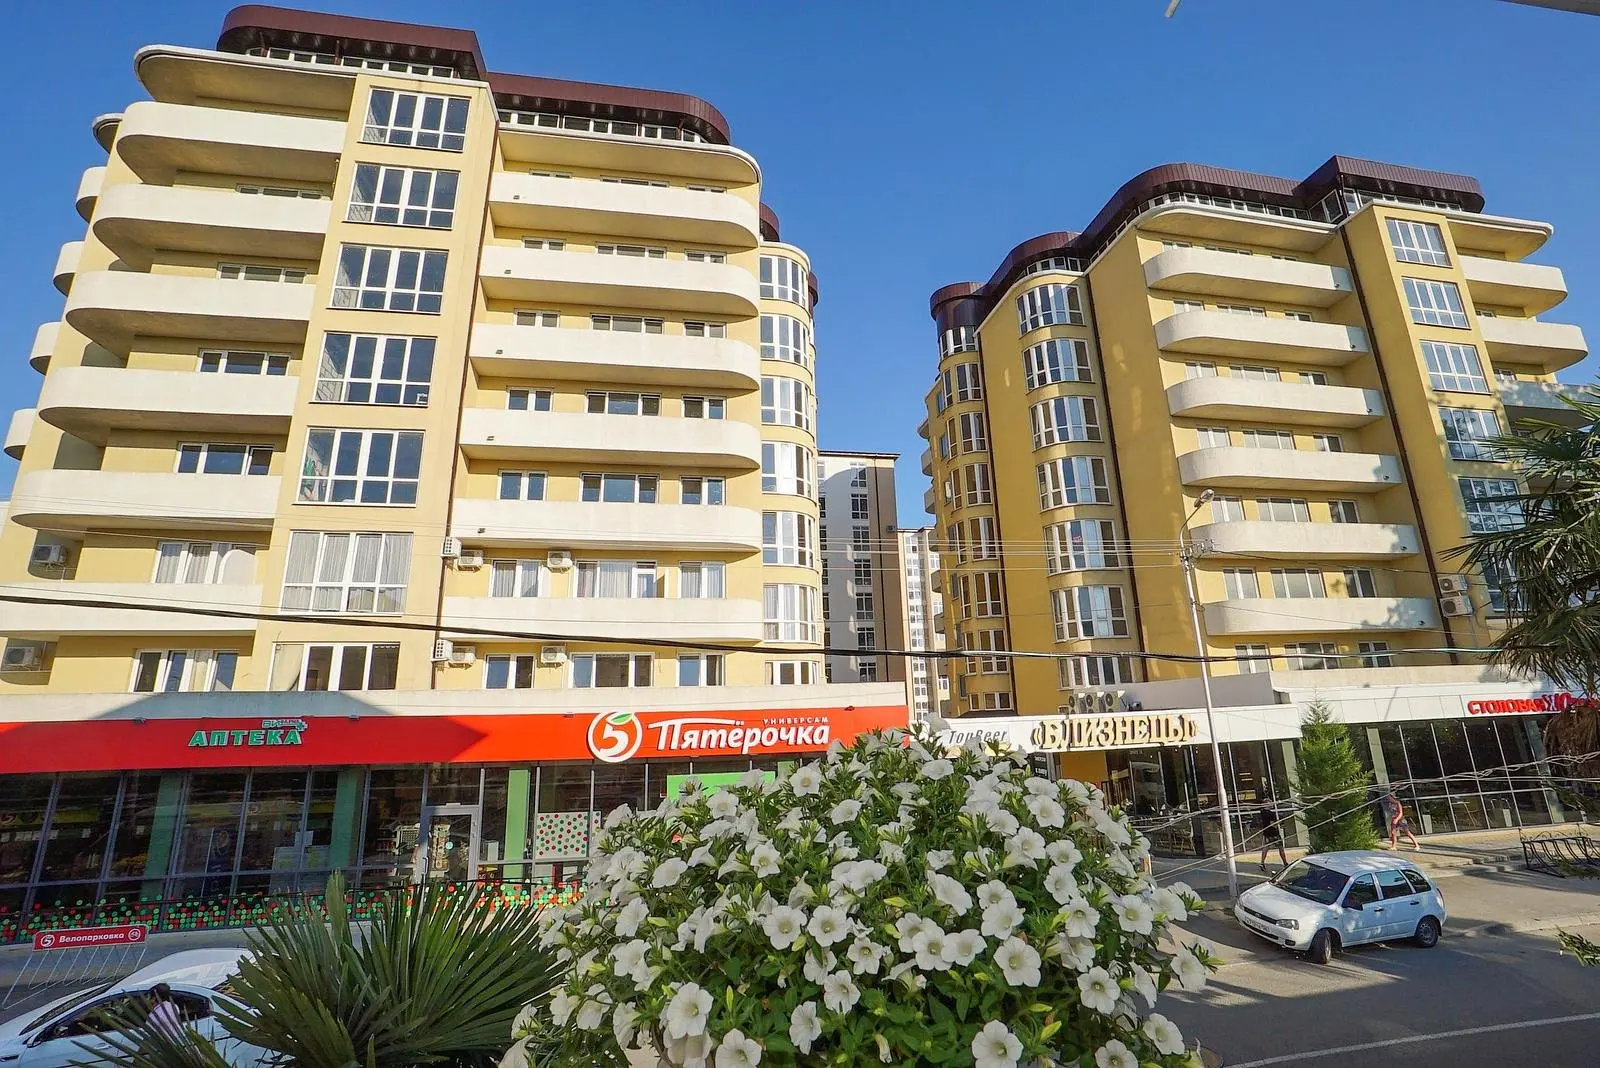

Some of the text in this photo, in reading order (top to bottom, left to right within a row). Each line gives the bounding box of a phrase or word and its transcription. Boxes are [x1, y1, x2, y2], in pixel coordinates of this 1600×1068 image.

[763, 716, 828, 725] УНИВЕРСАМ
[188, 729, 302, 747] АПТЕКА
[648, 717, 830, 755] Пятёрочка
[59, 933, 124, 943] Велопарковка
